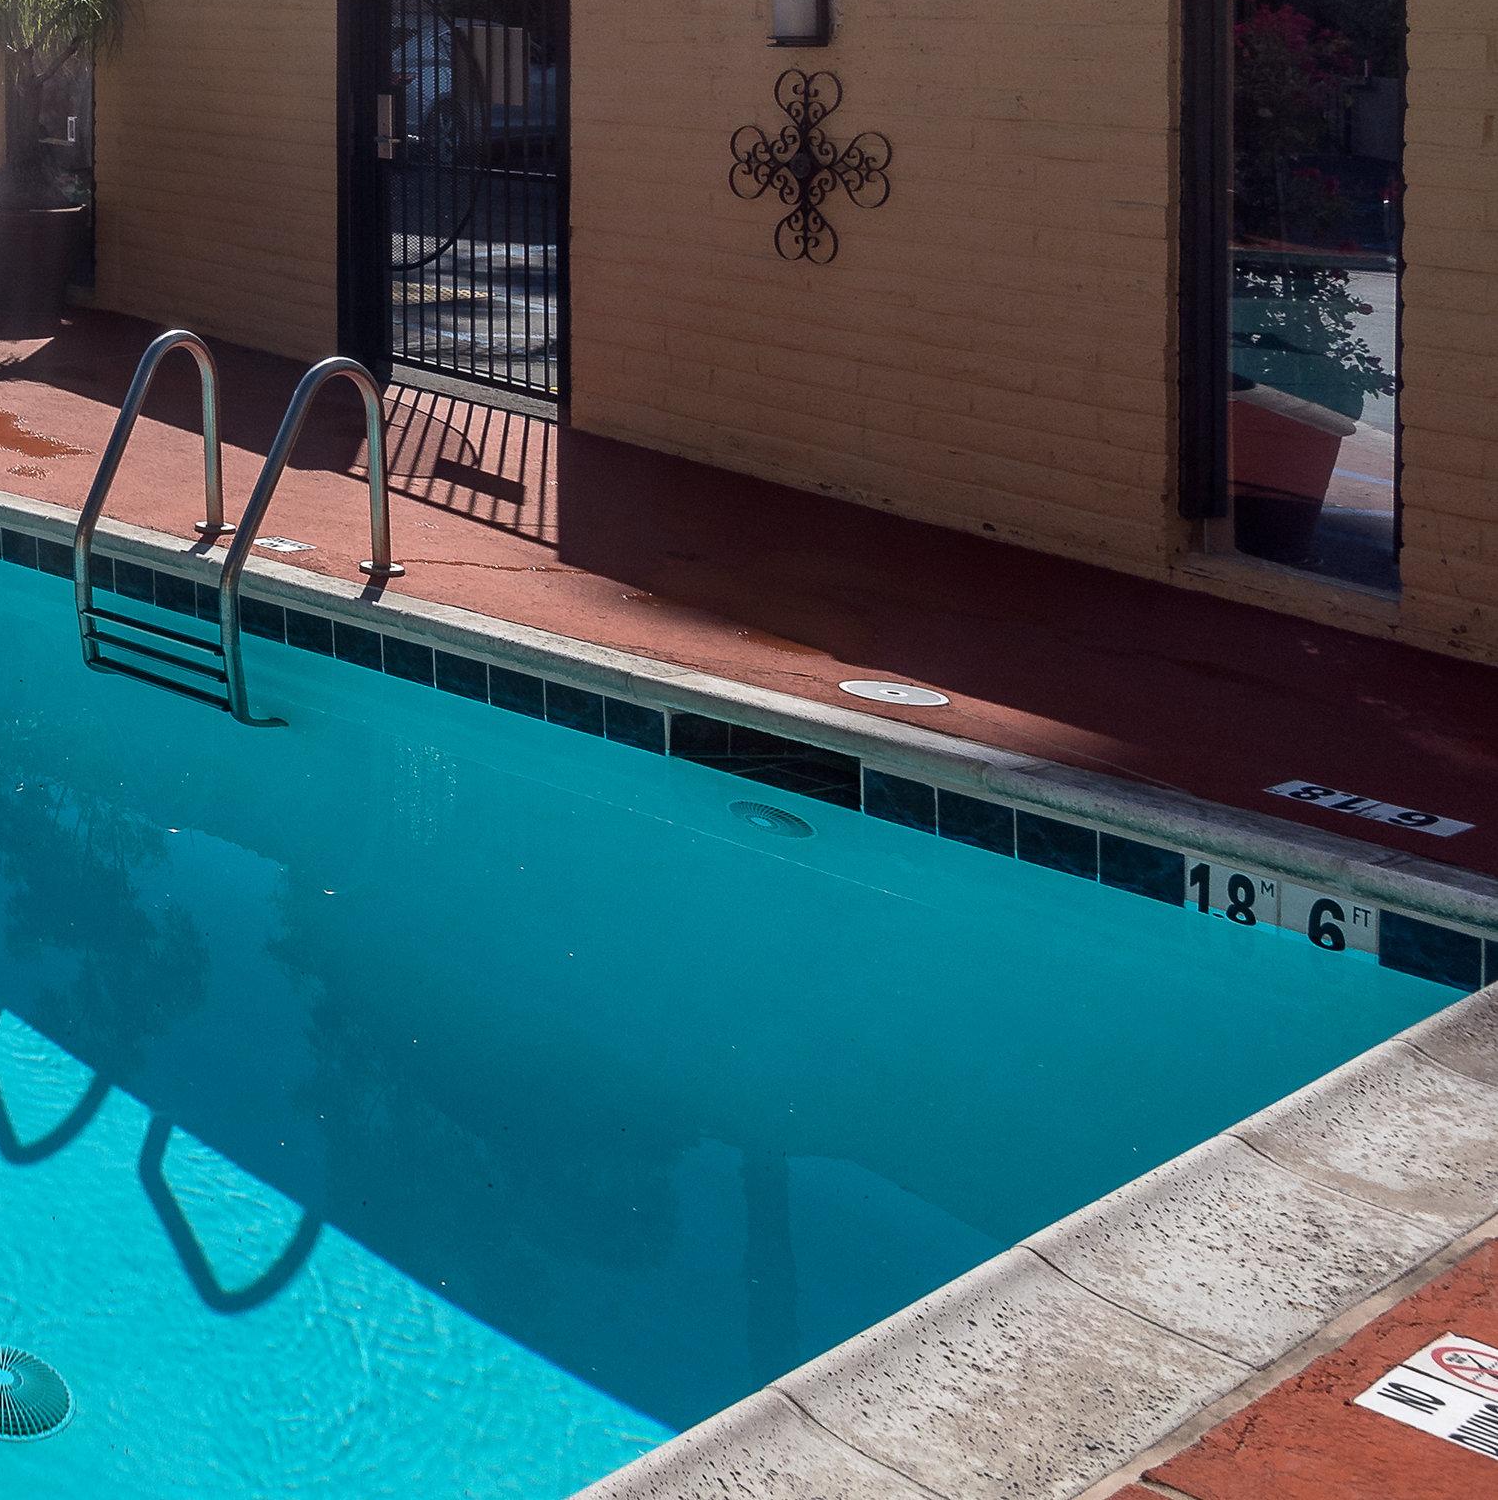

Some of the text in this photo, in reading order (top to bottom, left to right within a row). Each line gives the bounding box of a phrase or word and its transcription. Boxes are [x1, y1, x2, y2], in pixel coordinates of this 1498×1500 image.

[1307, 897, 1346, 952] 6
[1352, 906, 1372, 929] FT
[1376, 1381, 1446, 1416] NO
